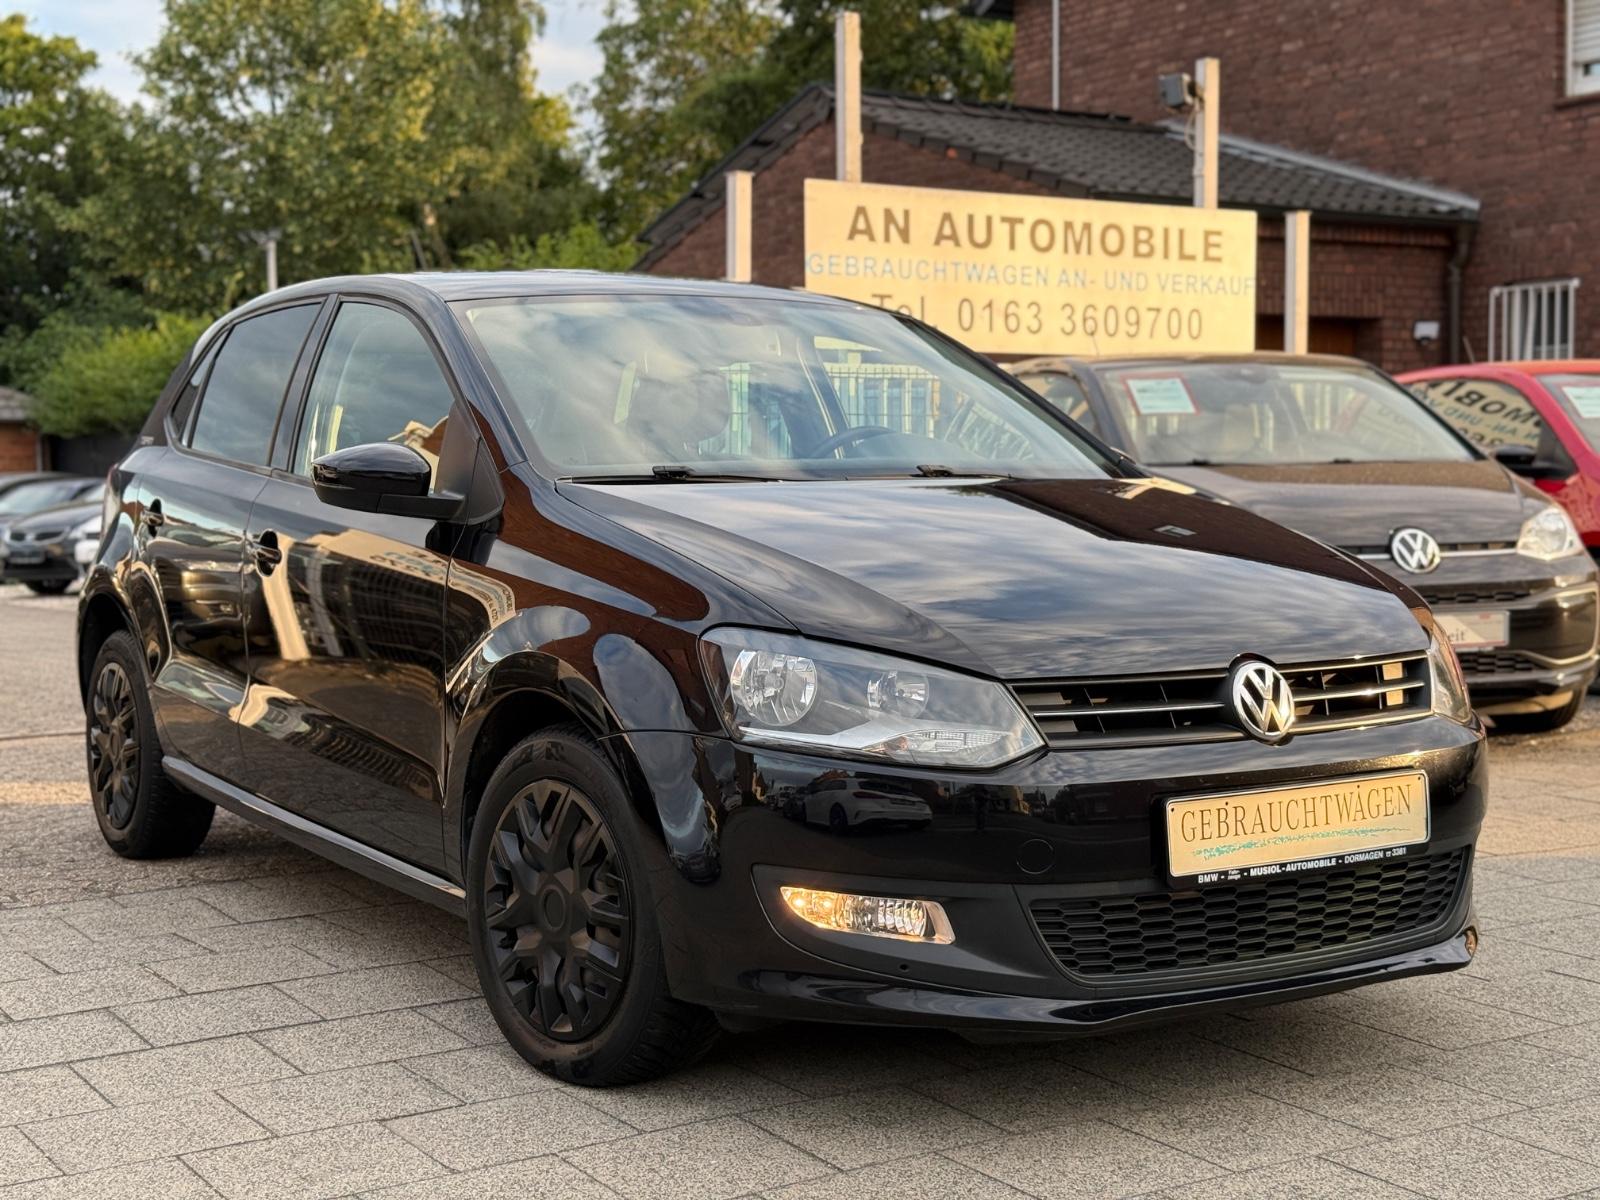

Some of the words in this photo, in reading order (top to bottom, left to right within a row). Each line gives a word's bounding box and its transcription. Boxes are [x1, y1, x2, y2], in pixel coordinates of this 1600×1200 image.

[847, 205, 911, 245] AN
[933, 211, 1223, 263] AUTOMOBILE
[805, 253, 1049, 287] GEBRAUCHTWAGEN
[1057, 267, 1095, 289] AN-
[1104, 270, 1149, 293] UND
[1157, 272, 1256, 297] VERKAUF
[957, 297, 1042, 335] 0163
[1060, 302, 1203, 341] 3609700
[1181, 784, 1411, 843] GEBRAUCHTWAGEN
[1198, 873, 1218, 883] BMW
[1345, 850, 1384, 864] DORMAGEN
